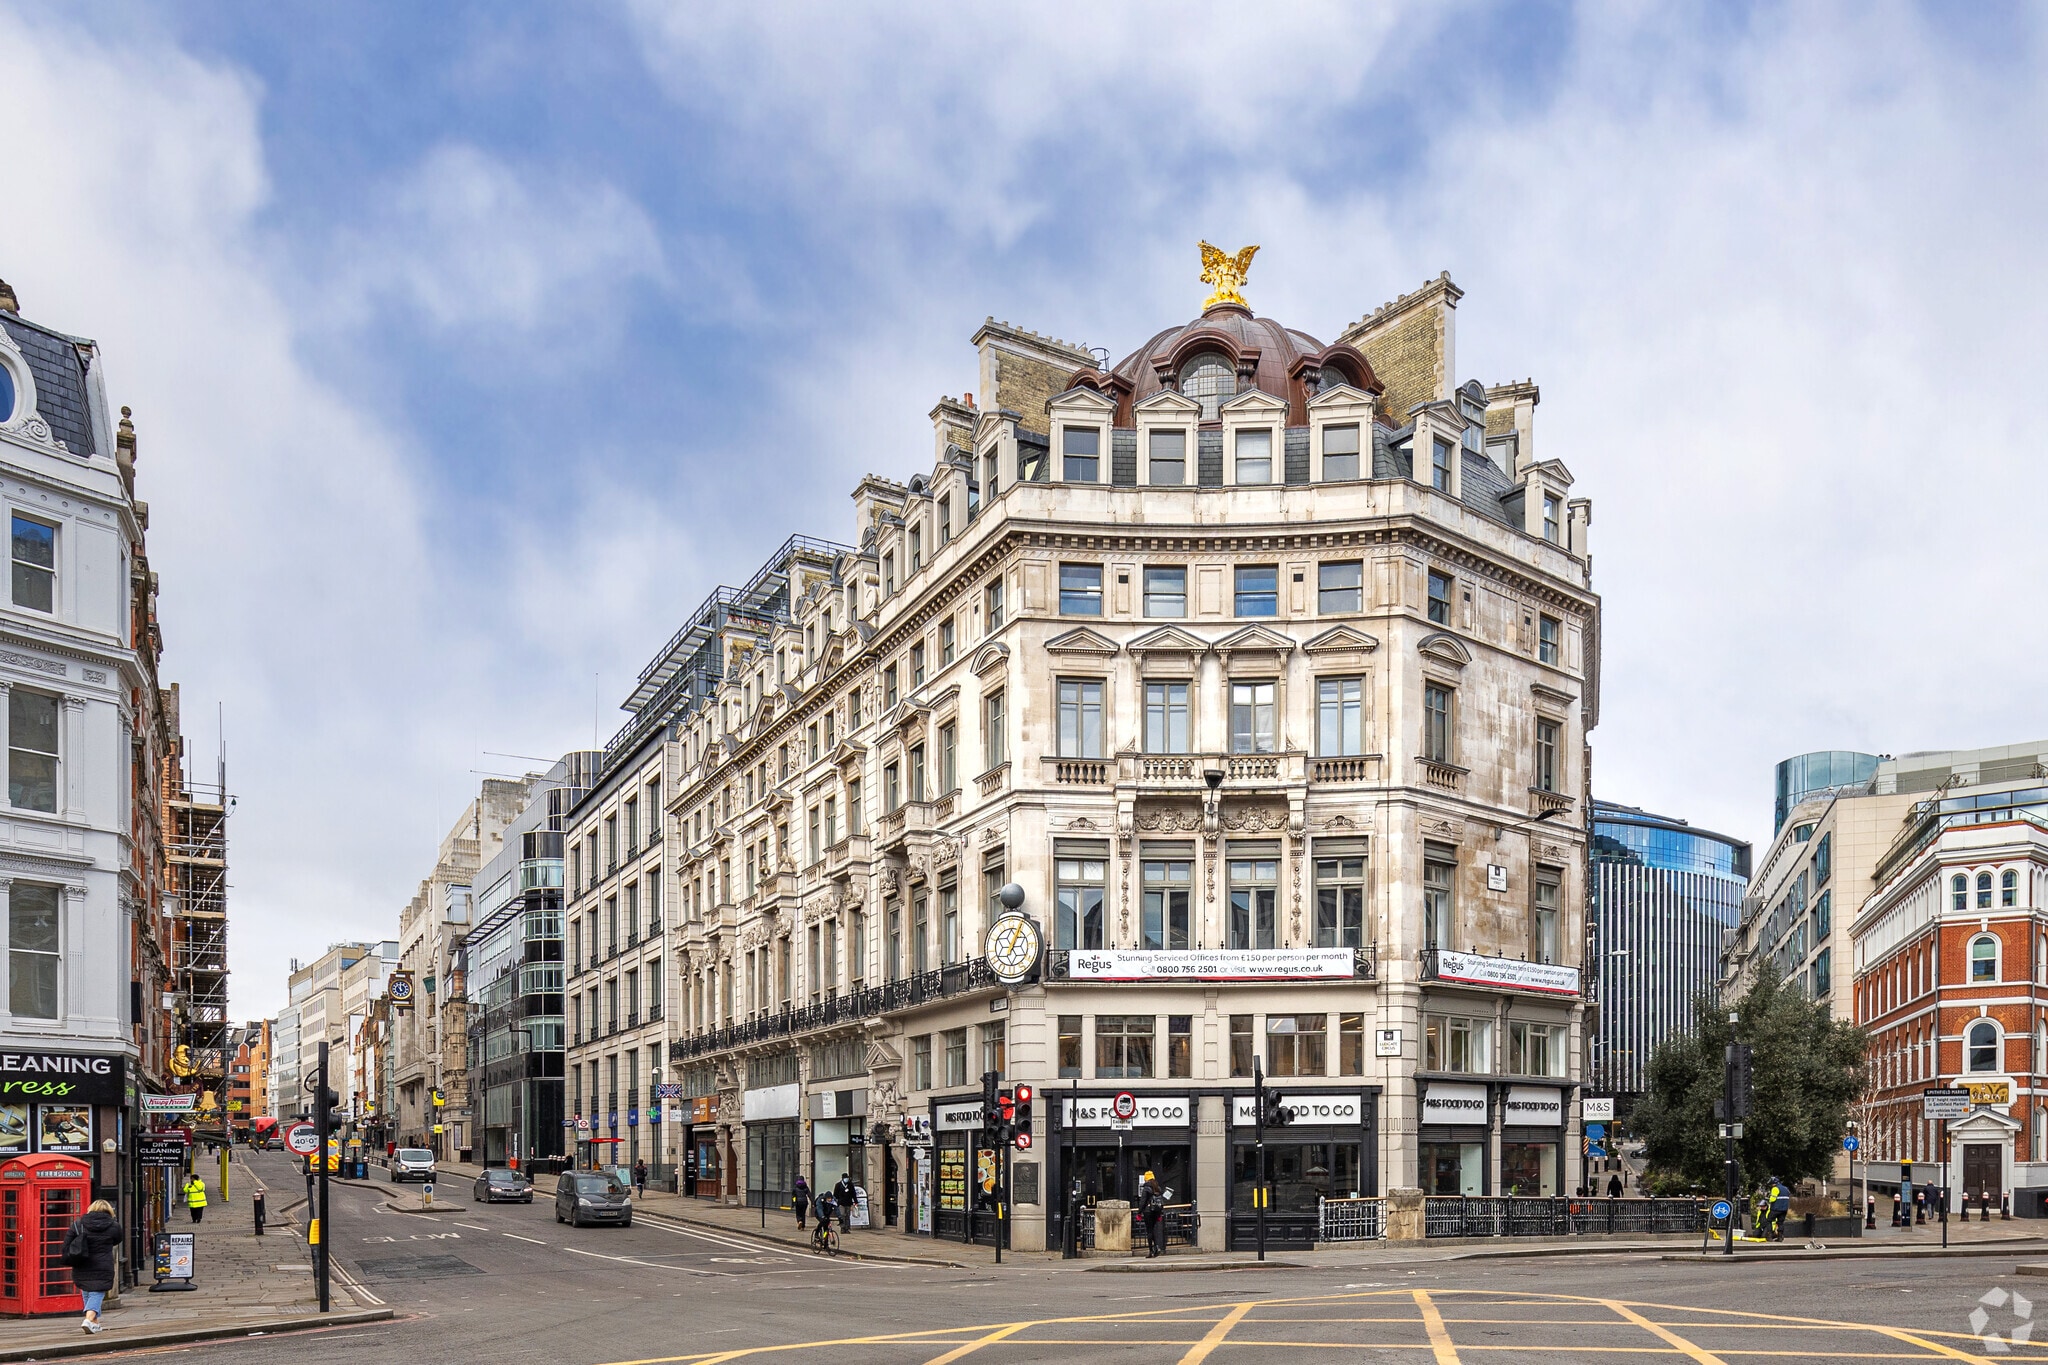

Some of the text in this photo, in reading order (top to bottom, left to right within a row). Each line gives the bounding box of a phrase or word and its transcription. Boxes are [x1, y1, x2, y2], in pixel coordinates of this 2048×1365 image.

[1117, 954, 1152, 964] Stunning
[1154, 954, 1188, 962] Serviced
[1190, 953, 1218, 962] Offices
[1220, 953, 1239, 961] from
[1262, 955, 1275, 963] per
[1277, 955, 1305, 963] person
[1306, 954, 1320, 962] per
[1078, 958, 1112, 974] Regus
[1141, 966, 1155, 974] Call
[1156, 965, 1179, 973] 0800
[1181, 965, 1196, 973] 756
[1198, 965, 1217, 973] 2501
[1230, 965, 1246, 973] visit
[1249, 964, 1323, 974] www.regus.co.uk
[1443, 958, 1464, 974] Regus
[1485, 960, 1503, 969] Serviced
[1487, 971, 1498, 979] 0800
[1531, 977, 1565, 986] www.regus.co.uk
[0, 1055, 111, 1074] EANING
[3, 1081, 76, 1096] ress
[1426, 1098, 1484, 1109] M&S FOOD TO GO
[1507, 1101, 1559, 1111] M&S FOOD TO GO
[1586, 1102, 1610, 1112] M&S
[956, 1111, 972, 1121] FOOD
[972, 1111, 979, 1120] TO
[1069, 1107, 1097, 1118] M&S
[1141, 1107, 1159, 1118] TO
[1162, 1107, 1183, 1118] GO
[1312, 1105, 1330, 1117] TO
[1333, 1105, 1354, 1116] GO
[38, 1170, 81, 1178] TELEPHONE
[362, 1233, 461, 1244] SLOW
